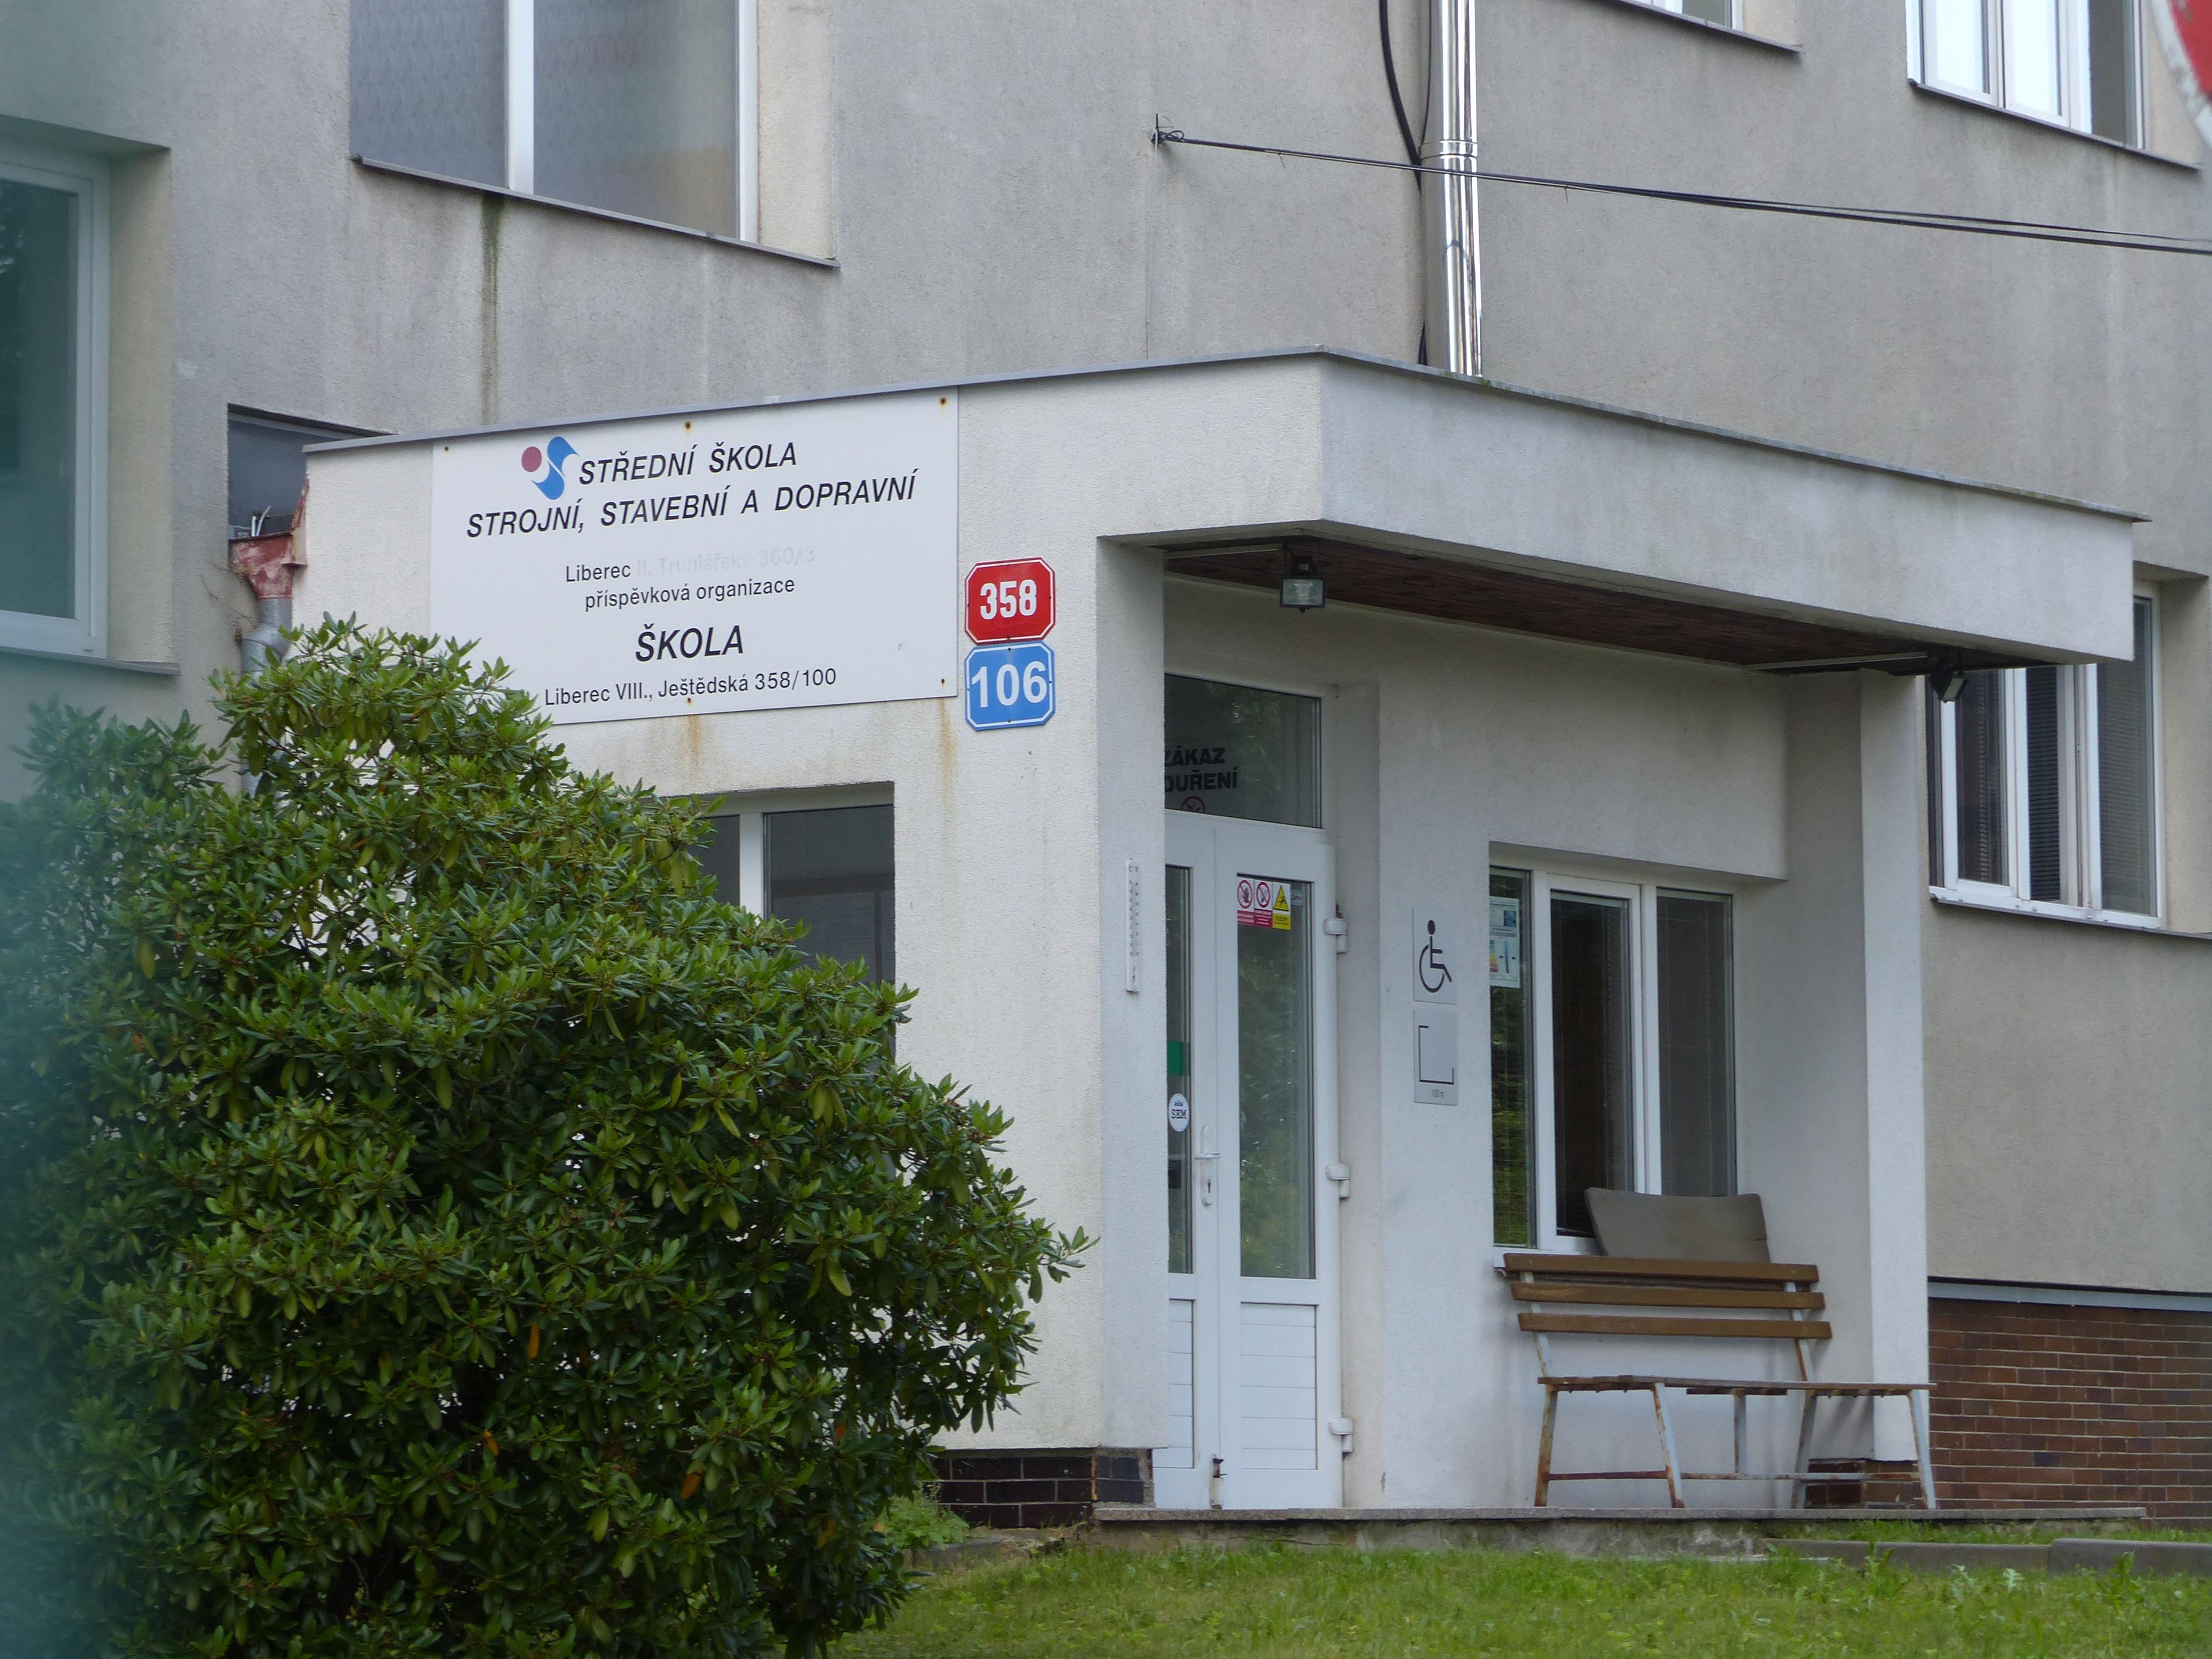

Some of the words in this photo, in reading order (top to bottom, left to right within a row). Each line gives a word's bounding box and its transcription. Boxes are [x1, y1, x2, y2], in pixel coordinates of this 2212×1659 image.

[579, 444, 698, 485] STŘEDNÍ
[708, 441, 797, 473] ŠKOLA
[466, 498, 583, 538] STROJNÍ,
[601, 484, 731, 527] STAVEBNÍ
[740, 489, 759, 514] A
[774, 468, 919, 511] DOPRAVNÍ
[566, 564, 631, 582] Liberec
[585, 583, 690, 612] příspěvková
[696, 578, 795, 602] organizace
[980, 578, 1037, 620] 358
[635, 623, 744, 662] ŠKOLA
[545, 687, 610, 706] Liberec
[658, 674, 748, 697] Ještědská
[755, 667, 837, 691] 358/100
[972, 661, 1047, 708] 106
